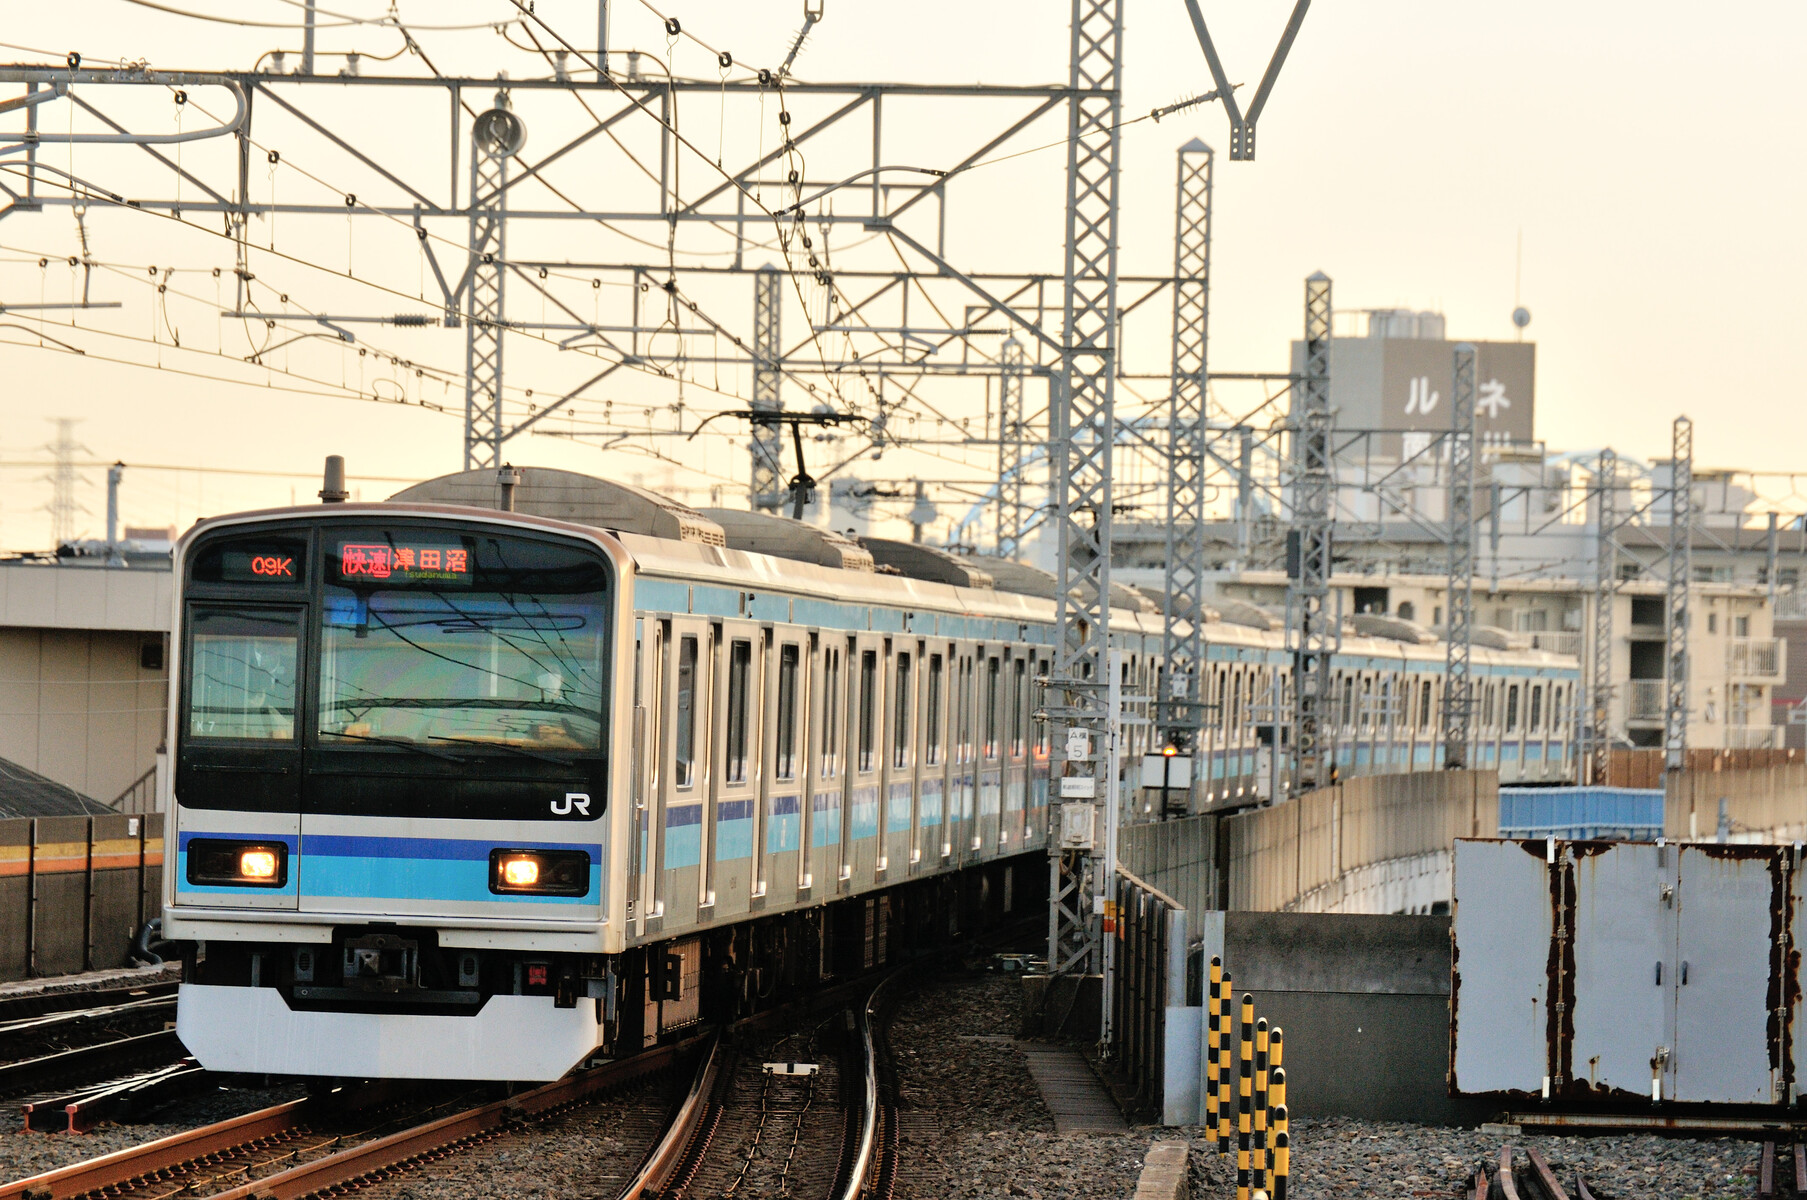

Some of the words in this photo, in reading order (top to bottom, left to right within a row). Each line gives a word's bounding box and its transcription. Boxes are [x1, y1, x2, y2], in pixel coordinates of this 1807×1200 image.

[251, 556, 292, 576] 09K
[343, 548, 388, 576] 快速
[393, 547, 467, 573] 津田沼
[1073, 745, 1082, 757] 5
[550, 793, 590, 815] JR
